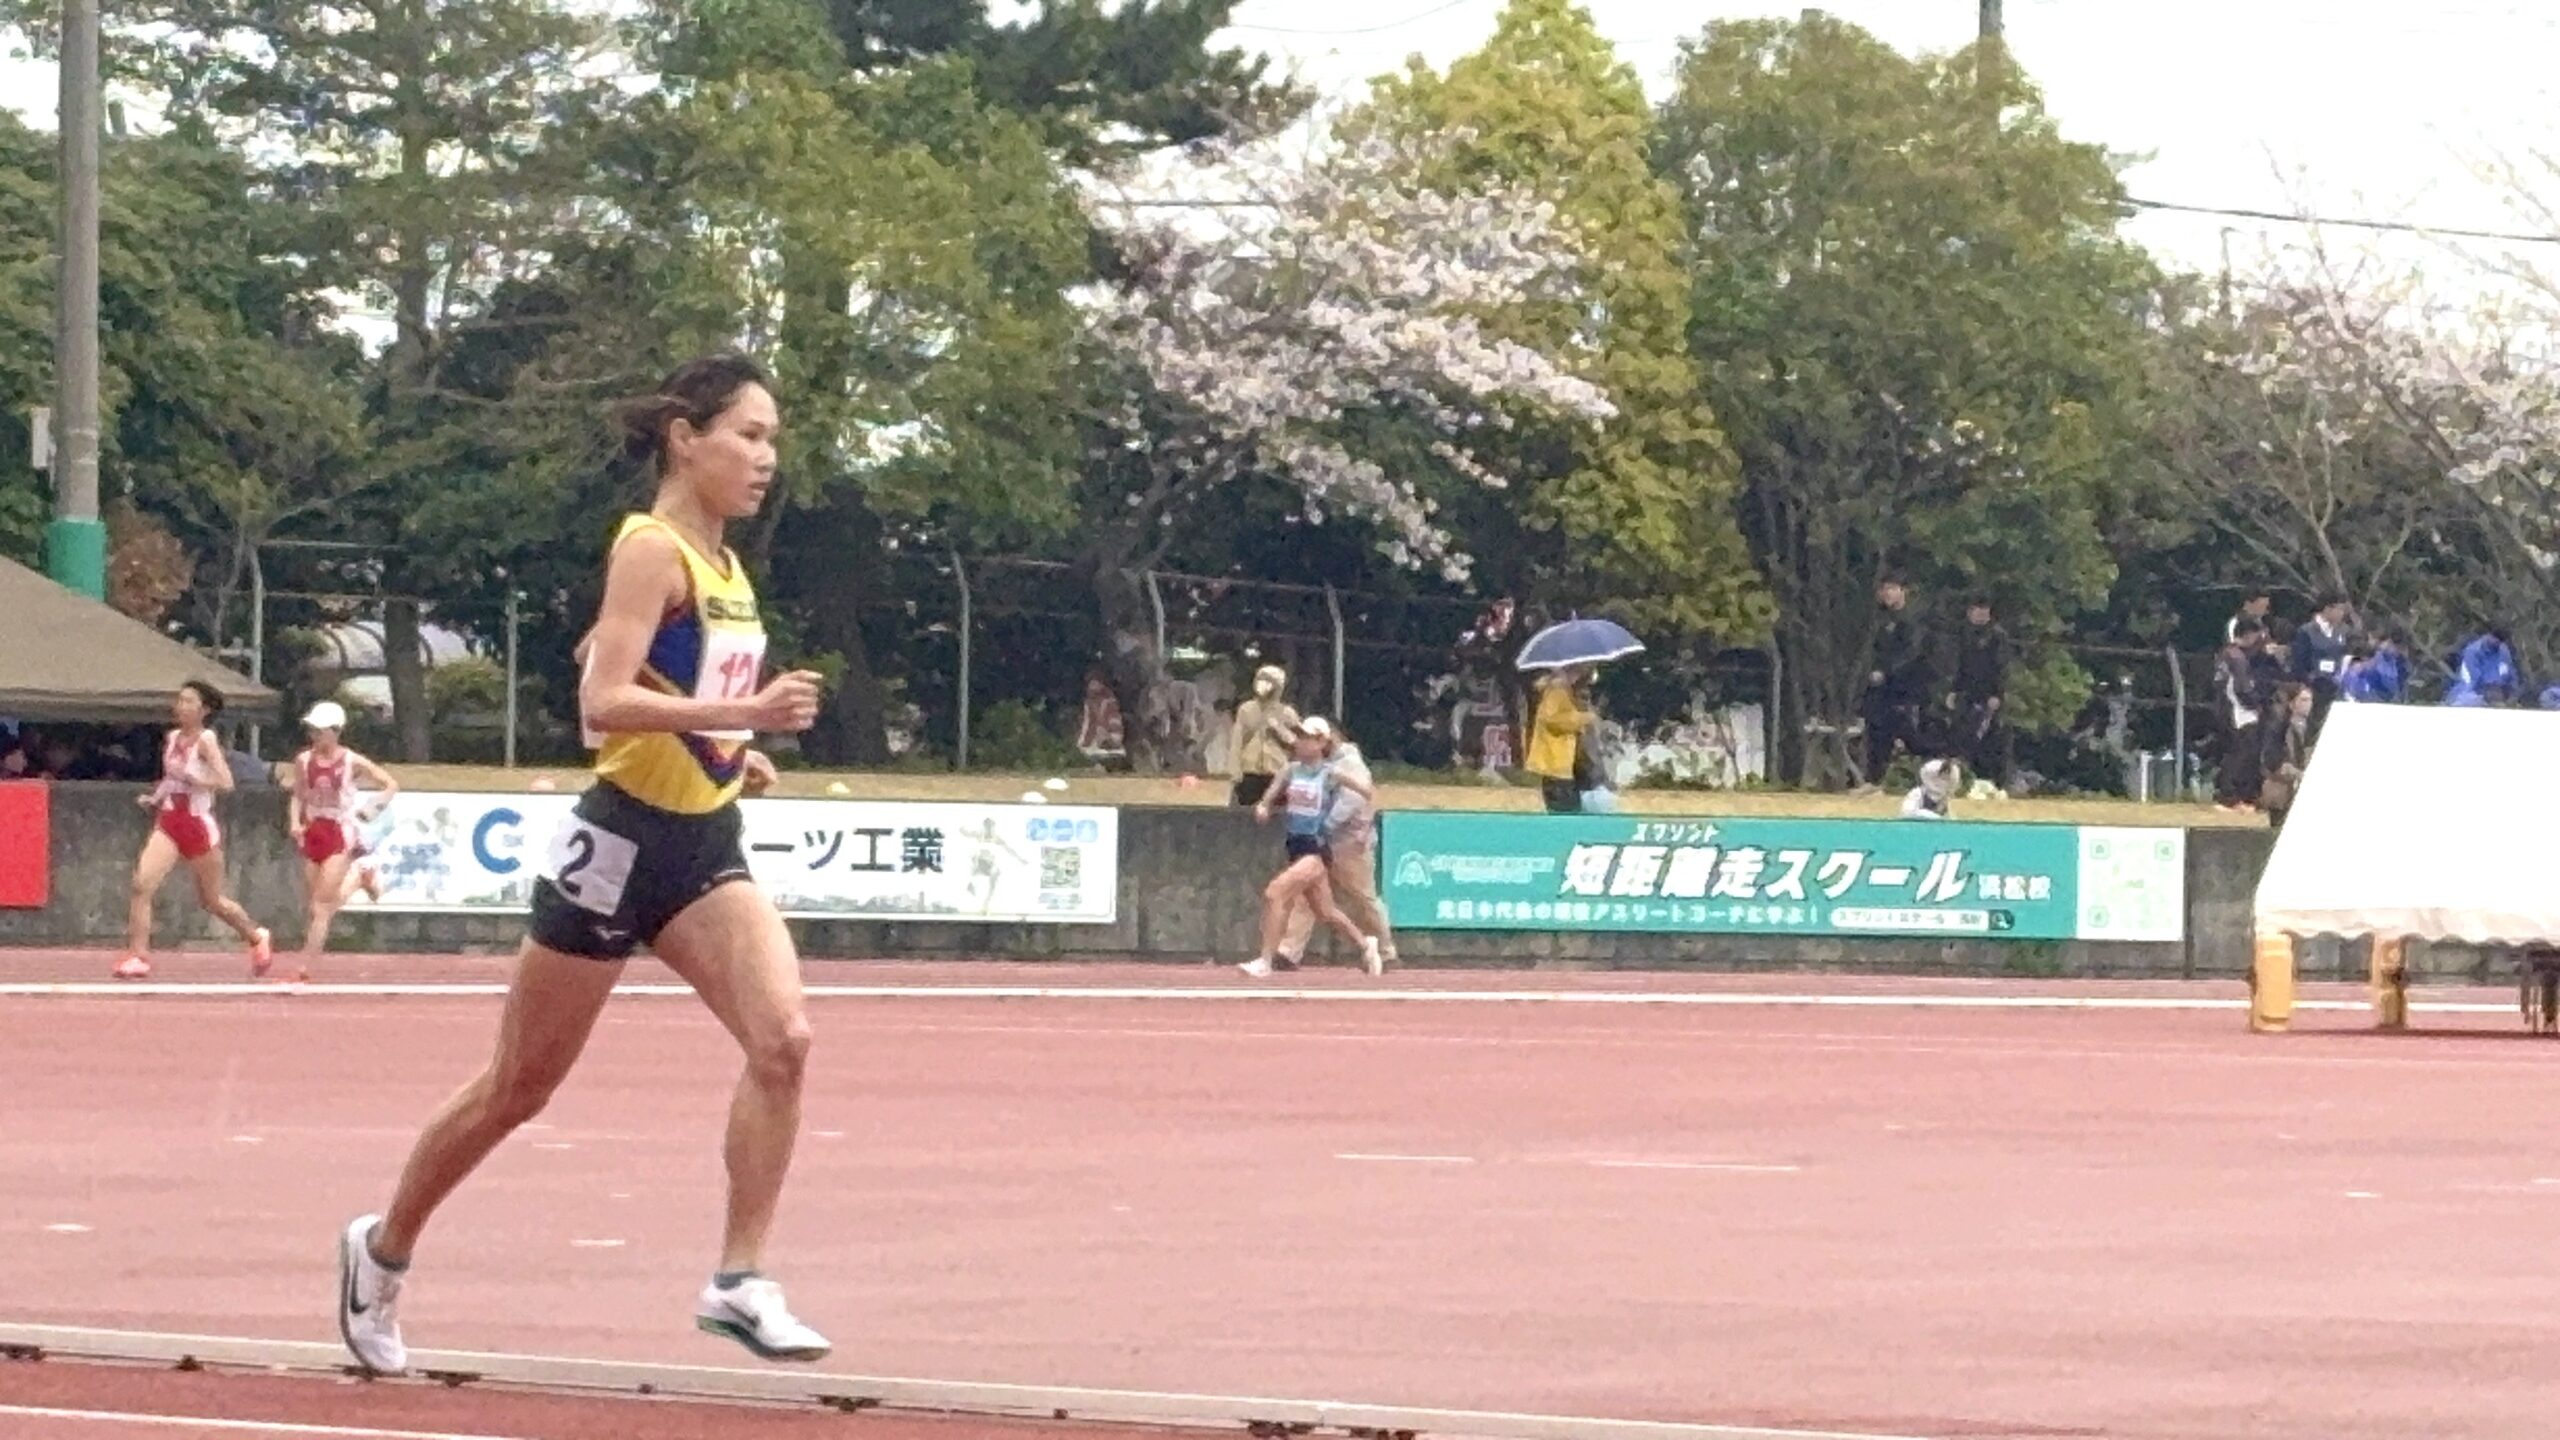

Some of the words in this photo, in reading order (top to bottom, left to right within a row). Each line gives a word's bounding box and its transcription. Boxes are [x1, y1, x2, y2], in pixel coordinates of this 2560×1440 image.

[558, 829, 595, 898] 2
[750, 827, 944, 874] ーツ工業
